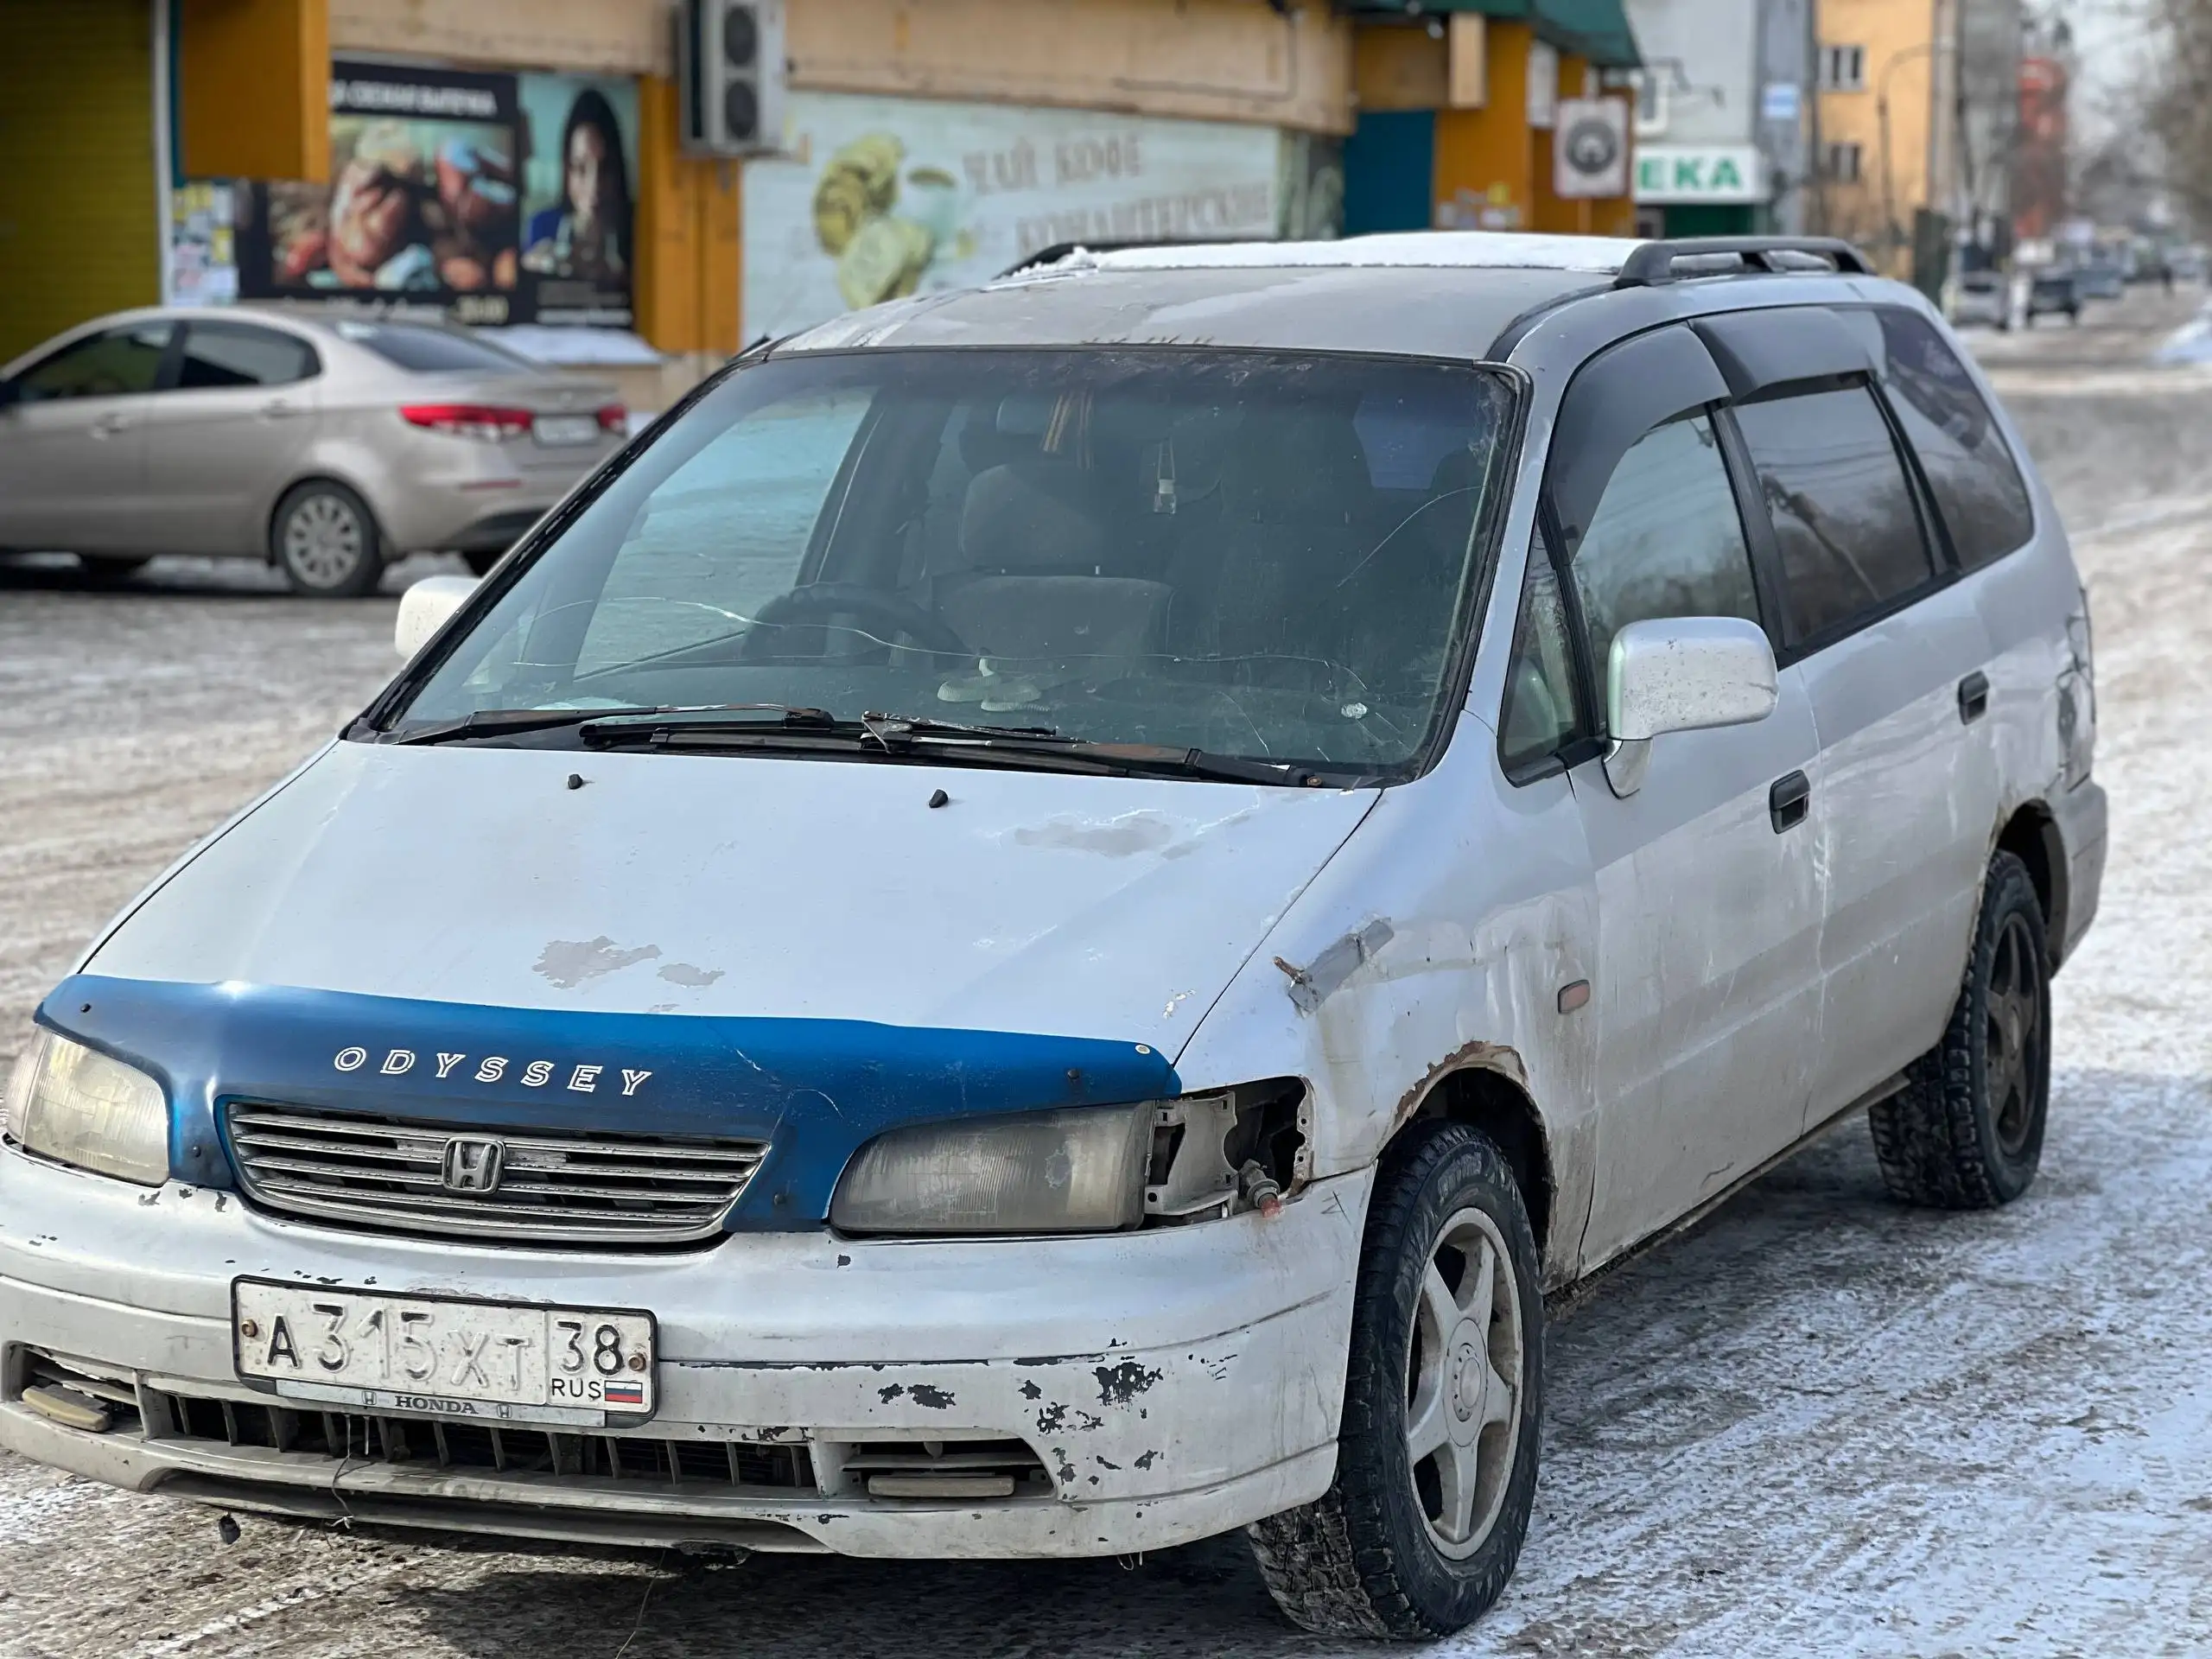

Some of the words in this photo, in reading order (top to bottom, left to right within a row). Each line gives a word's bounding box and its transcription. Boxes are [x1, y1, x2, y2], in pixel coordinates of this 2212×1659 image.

[334, 1046, 652, 1096] ODYSSEY
[554, 1319, 626, 1376] 38
[394, 1395, 479, 1415] HONDA
[551, 1377, 602, 1401] RUS
